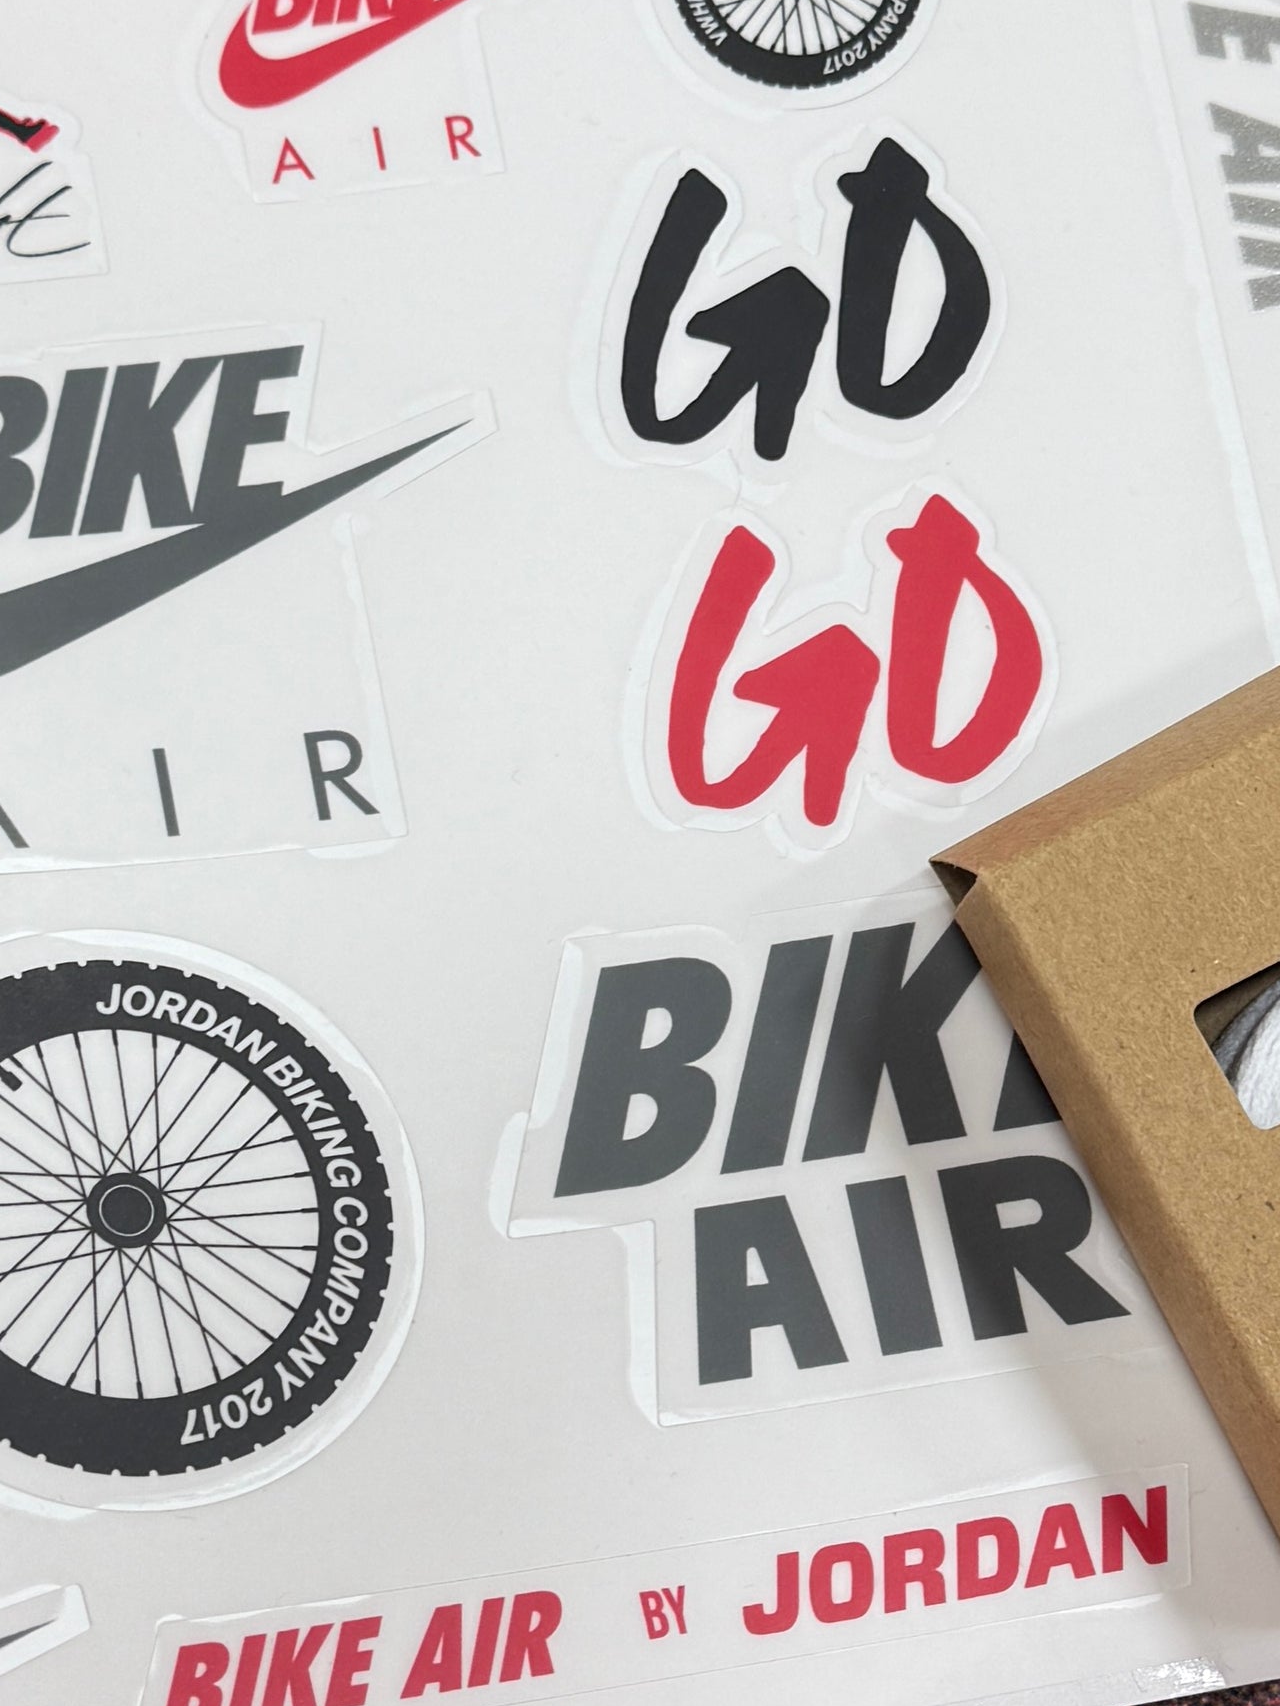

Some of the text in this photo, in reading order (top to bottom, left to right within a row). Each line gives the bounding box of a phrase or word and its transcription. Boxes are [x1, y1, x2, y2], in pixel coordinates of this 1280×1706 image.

[823, 41, 867, 75] 2017
[621, 137, 990, 461] GO
[668, 494, 1042, 826] GO
[96, 983, 369, 1446] JORDAN BIKING COMPANY 2017
[694, 1154, 1131, 1386] AIR
[401, 1590, 562, 1699] AIR
[639, 1585, 686, 1640] BY
[742, 1484, 1169, 1635] JORDAN
